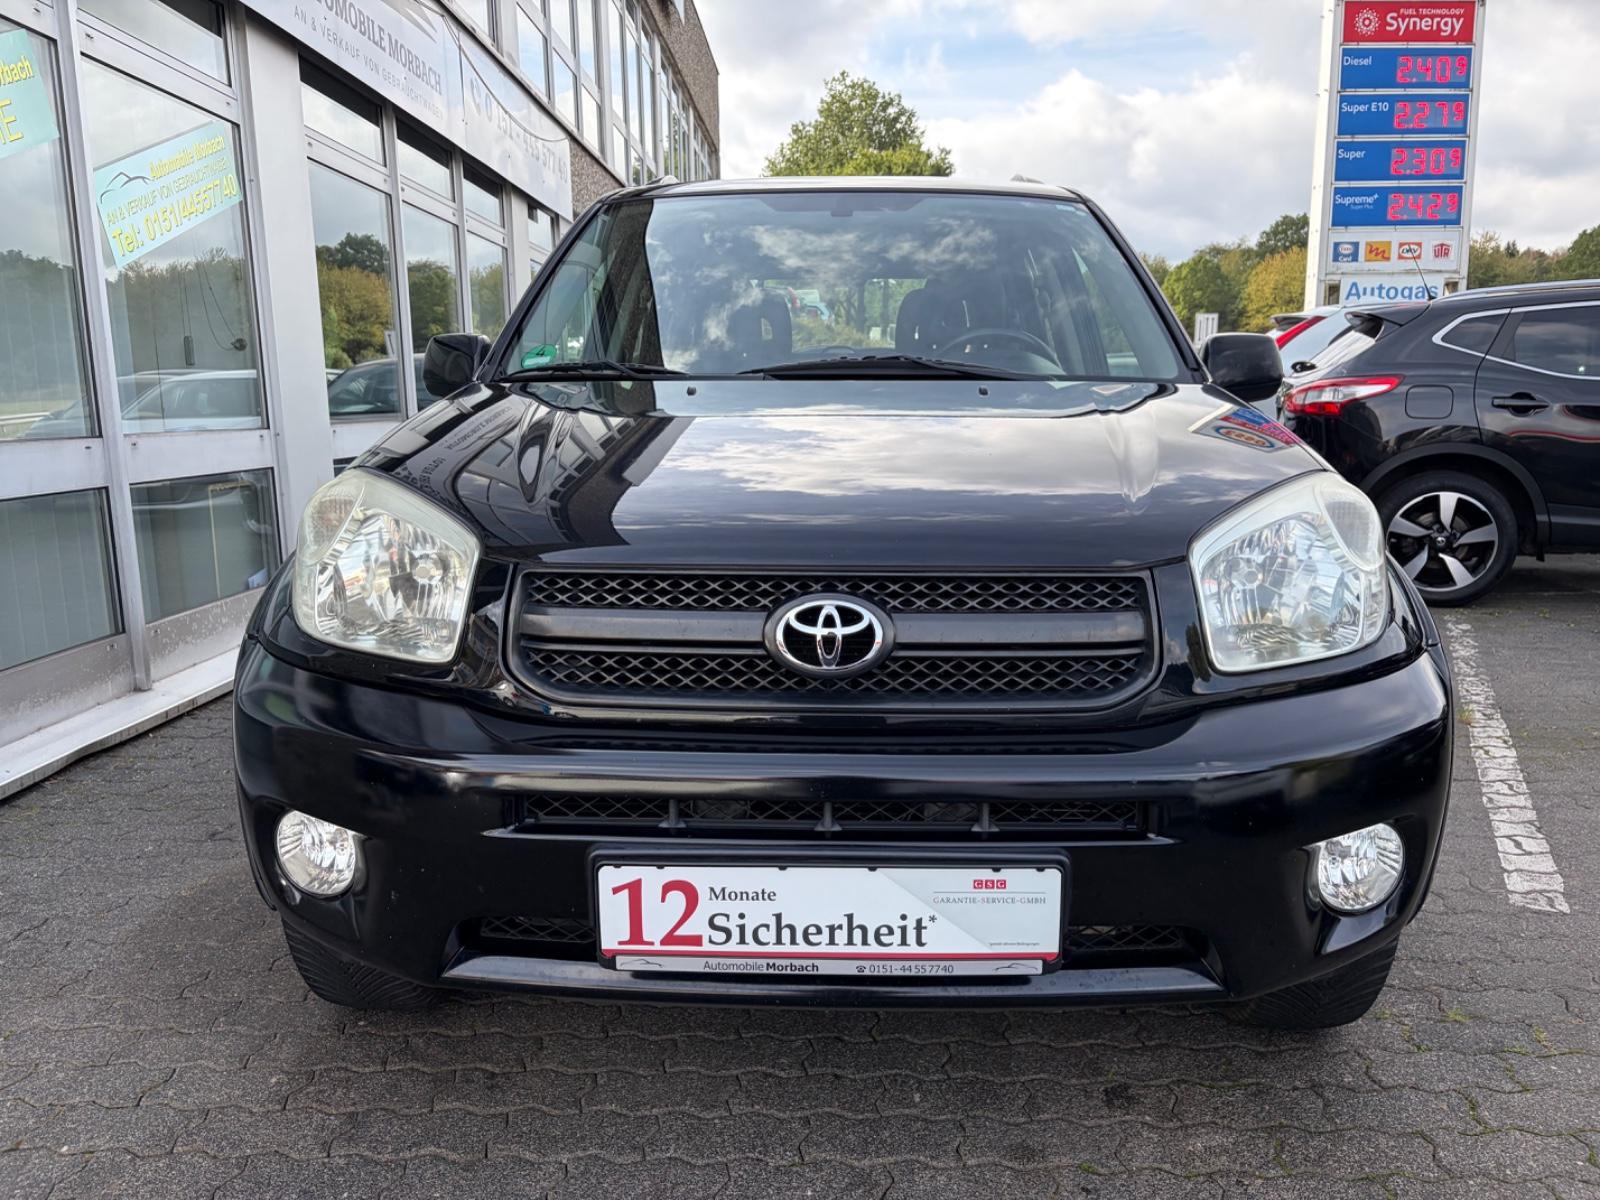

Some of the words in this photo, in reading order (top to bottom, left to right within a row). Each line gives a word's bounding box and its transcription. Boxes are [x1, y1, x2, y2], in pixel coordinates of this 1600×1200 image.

[1386, 13, 1465, 36] Synergy
[294, 5, 307, 25] AN
[311, 17, 317, 32] &
[320, 23, 361, 60] VERKAUF
[363, 55, 380, 75] VON
[388, 32, 442, 96] MORBACH
[1343, 56, 1372, 66] Diesel
[1341, 102, 1369, 115] Super
[1371, 102, 1389, 112] E10
[1338, 148, 1365, 161] Super
[112, 224, 144, 257] Tel:
[1345, 281, 1439, 301] Autogas
[973, 880, 1006, 889] GSG
[708, 886, 777, 902] Monate
[611, 878, 703, 947] 12
[703, 961, 764, 971] Automobile
[766, 962, 819, 972] Morbach
